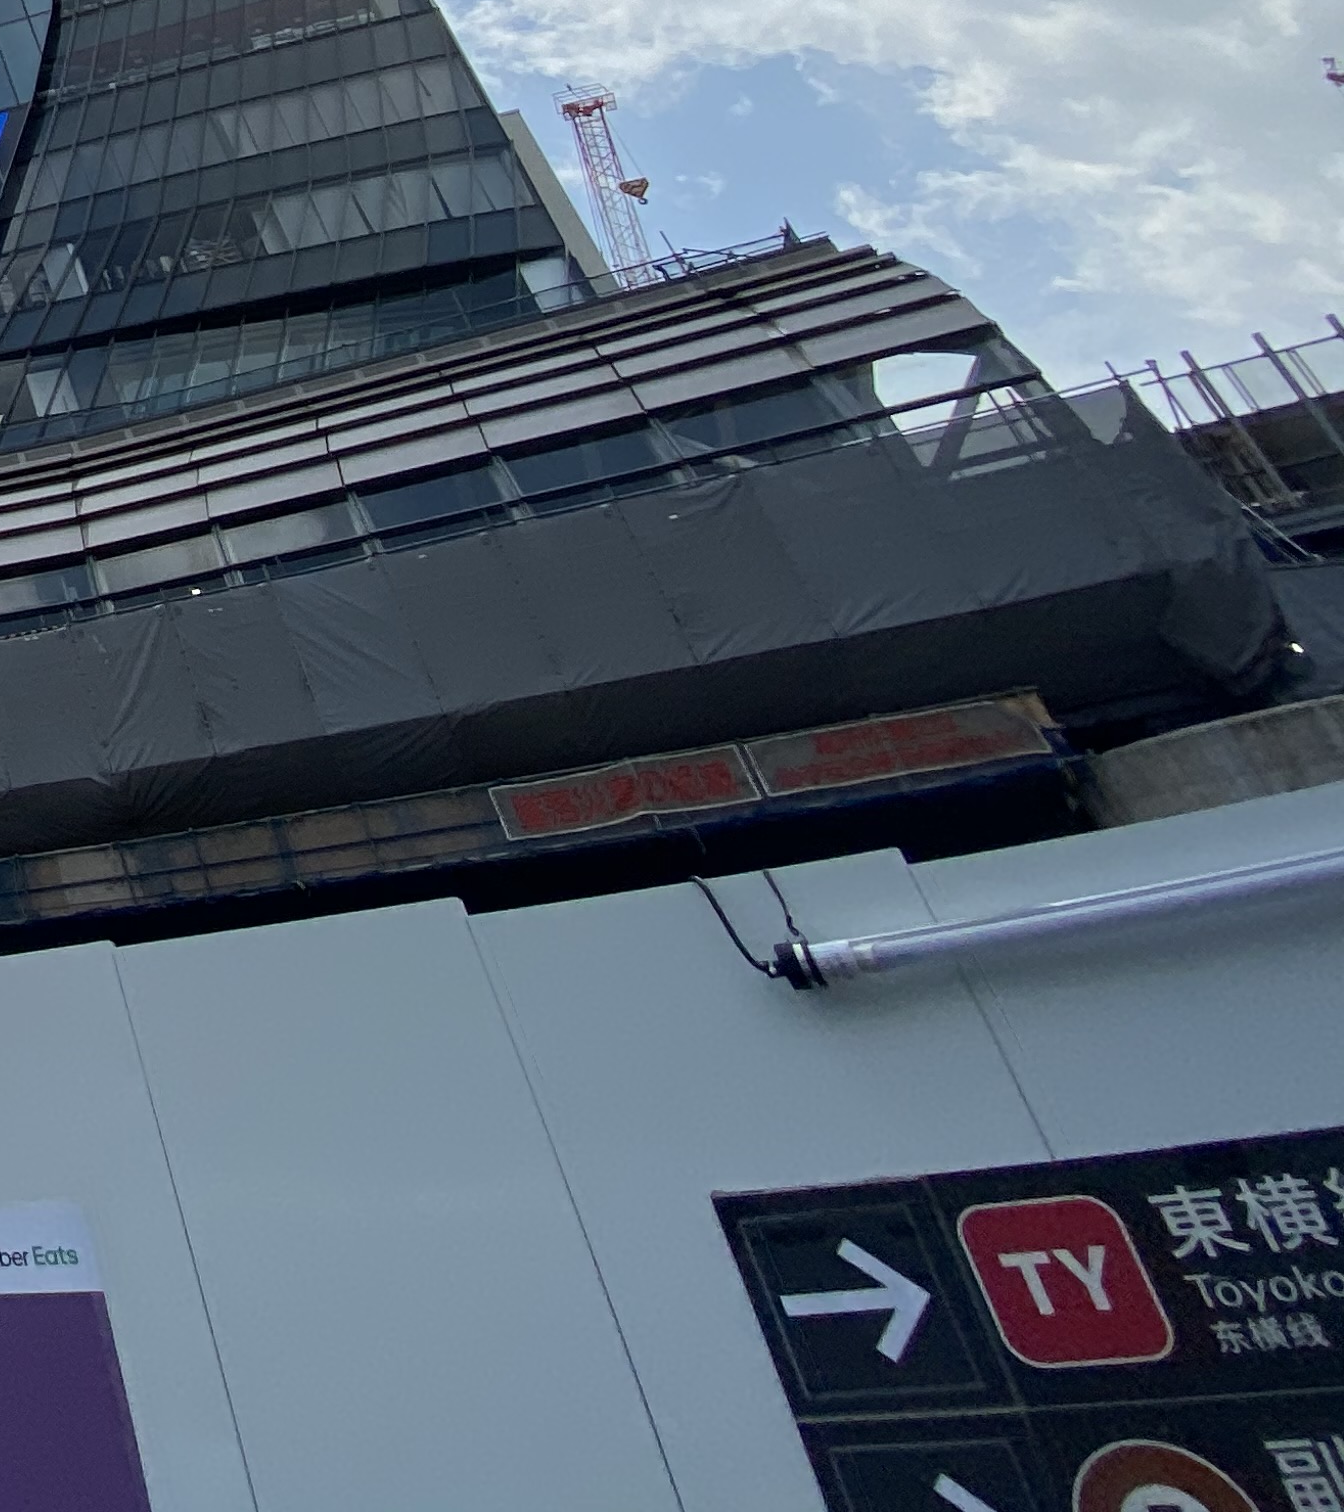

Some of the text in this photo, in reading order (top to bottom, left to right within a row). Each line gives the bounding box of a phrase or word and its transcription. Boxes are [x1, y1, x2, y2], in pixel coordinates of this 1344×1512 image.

[1147, 1167, 1344, 1260] 東横
[33, 1245, 79, 1266] Eats
[997, 1245, 1113, 1316] TY
[1183, 1266, 1344, 1312] Toyoko
